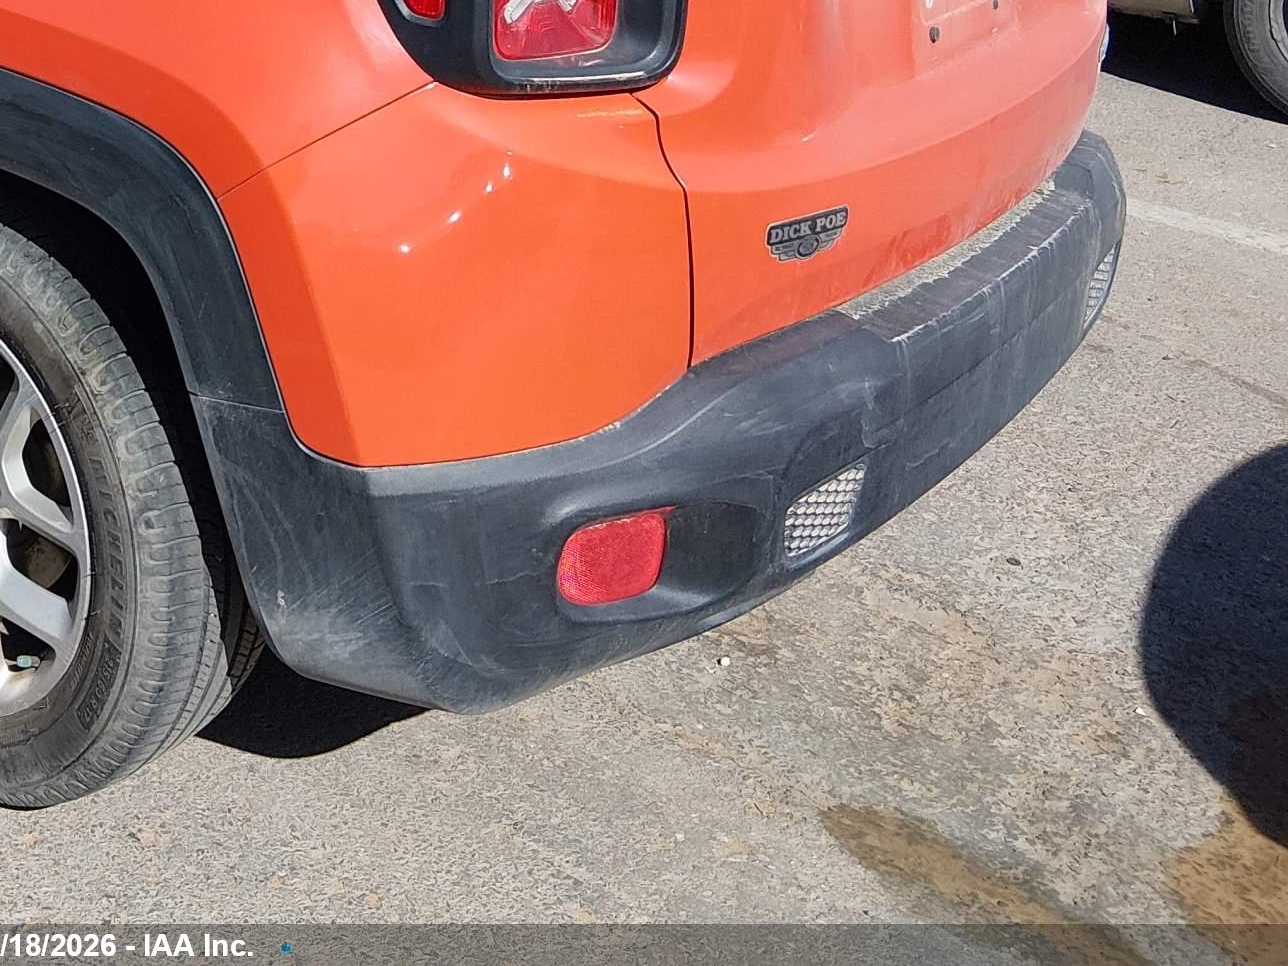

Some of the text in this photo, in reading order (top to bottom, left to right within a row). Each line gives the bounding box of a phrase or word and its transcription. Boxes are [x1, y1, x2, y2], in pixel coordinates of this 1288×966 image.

[769, 220, 813, 244] DICK
[815, 211, 848, 233] POE
[89, 457, 125, 640] MICHELIN
